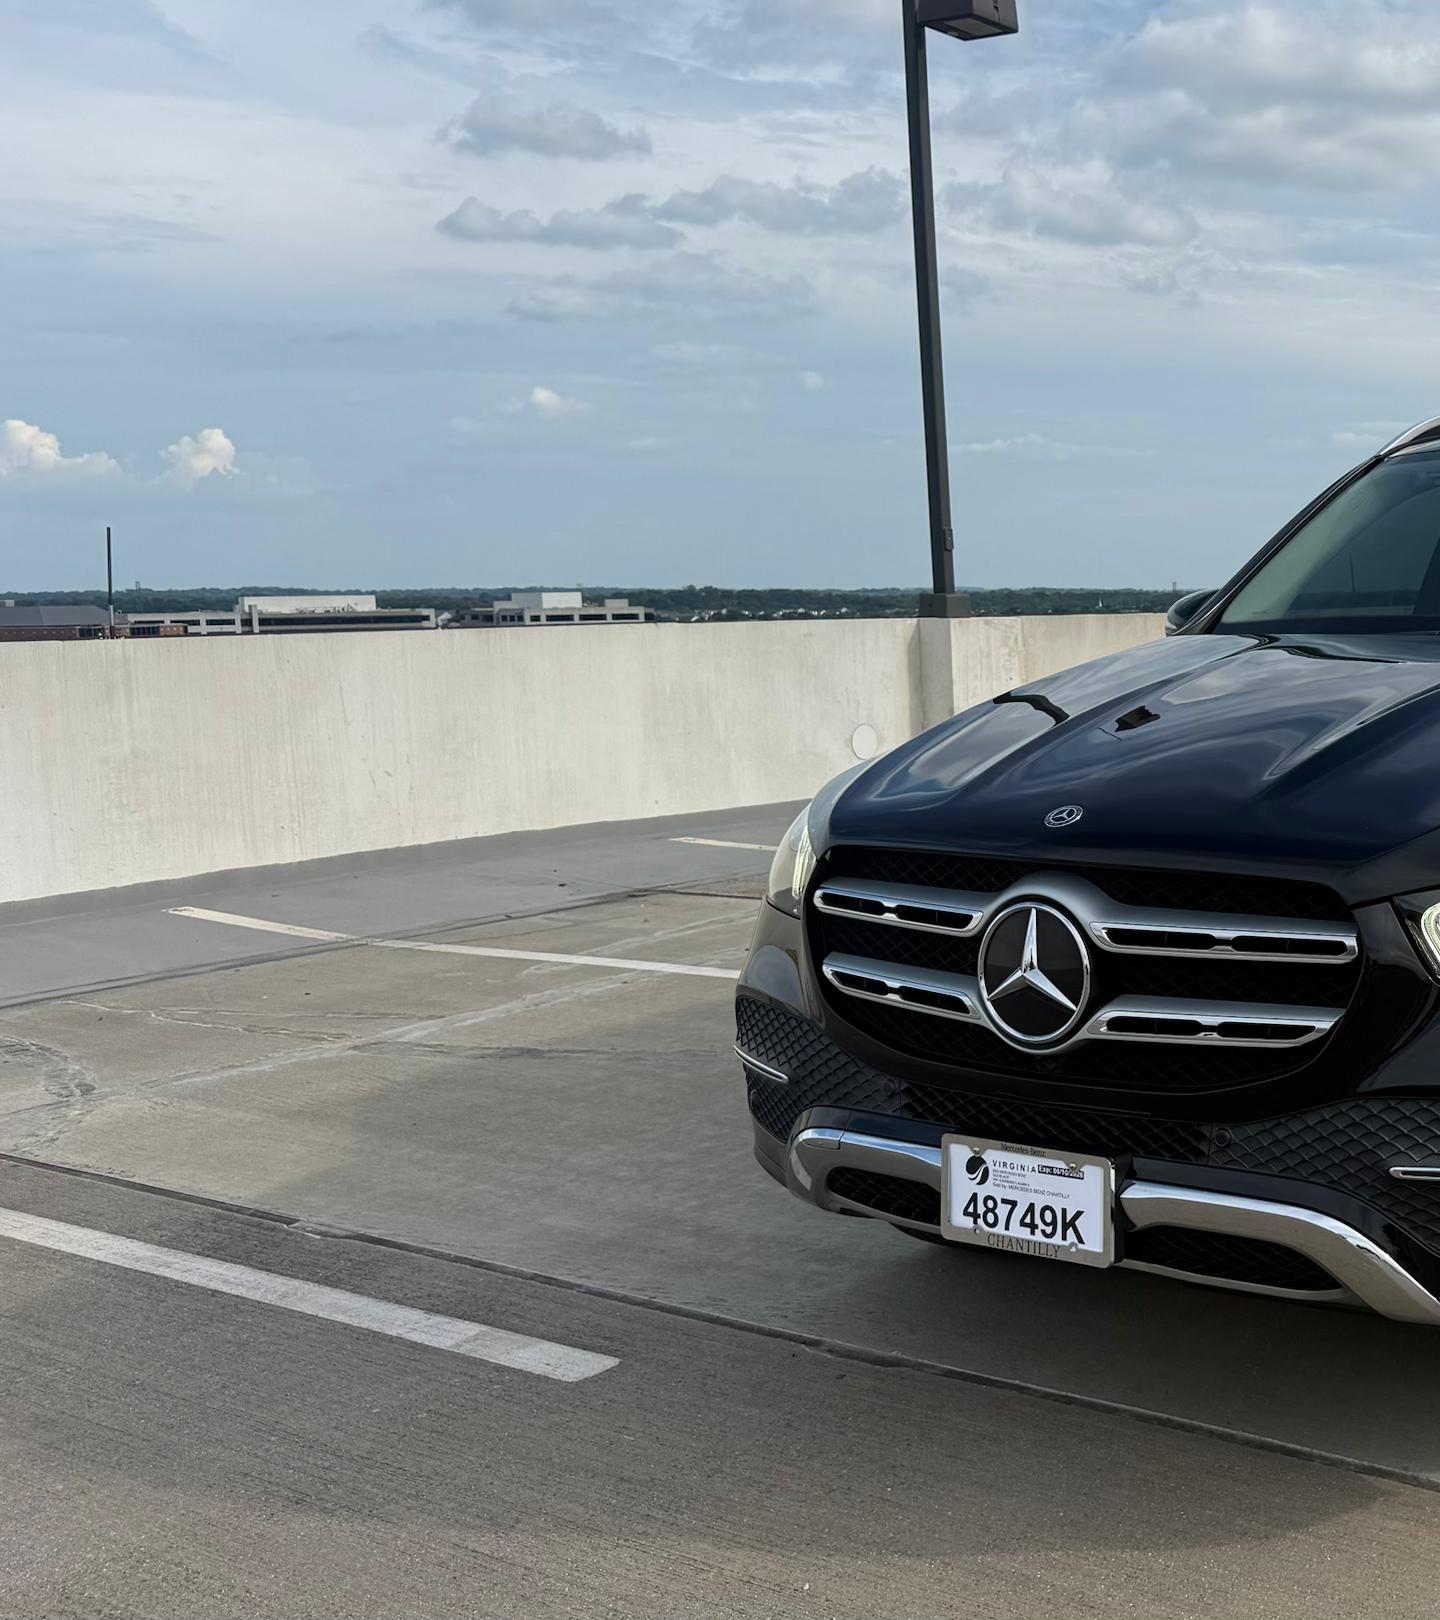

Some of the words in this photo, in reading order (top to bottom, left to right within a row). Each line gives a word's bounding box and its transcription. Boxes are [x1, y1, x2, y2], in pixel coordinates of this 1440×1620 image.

[992, 1160, 1037, 1173] VIRGINIA
[962, 1192, 1085, 1245] 48749K
[987, 1233, 1061, 1258] CHANTILLY
